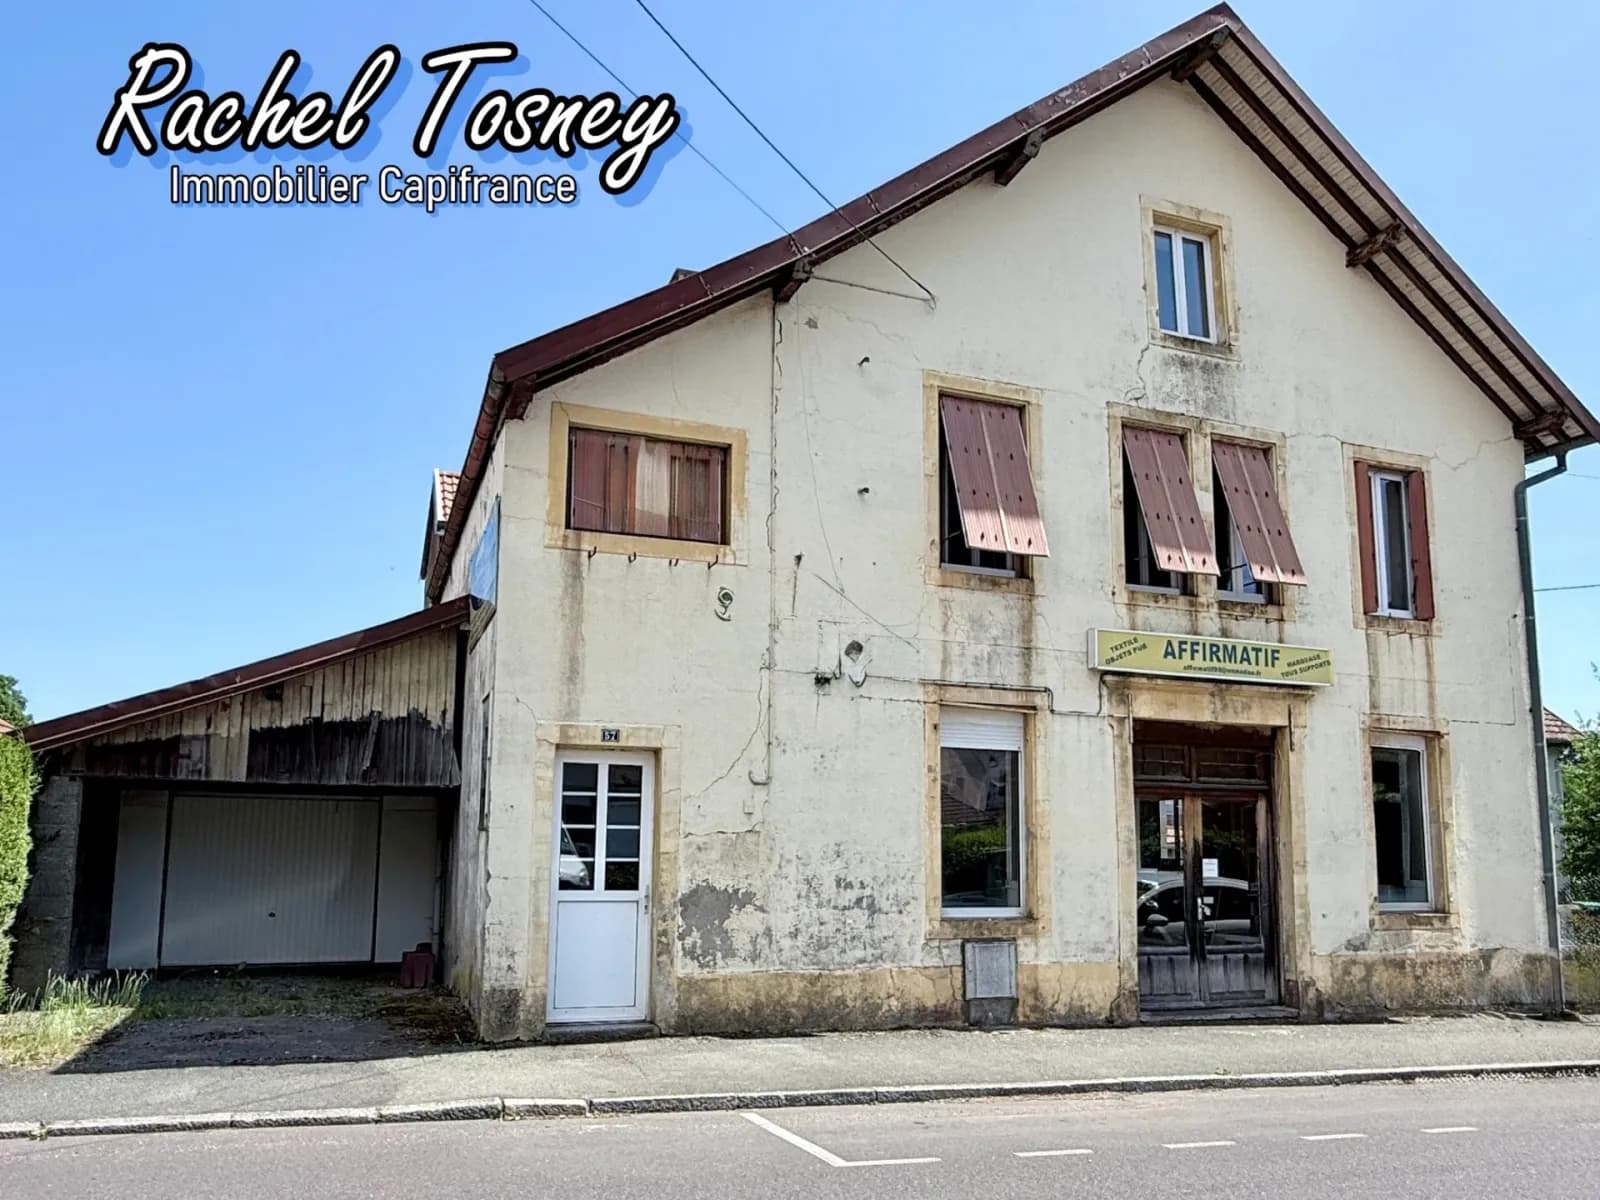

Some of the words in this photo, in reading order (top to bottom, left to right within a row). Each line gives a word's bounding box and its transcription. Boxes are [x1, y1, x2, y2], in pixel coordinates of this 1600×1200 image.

[1109, 636, 1139, 653] TEXTILE
[1104, 649, 1133, 665] OBJETS
[1162, 639, 1281, 668] AFFIRMATIF
[1286, 653, 1321, 668] MARQUAGE
[1280, 668, 1298, 678] TOUS
[1298, 659, 1332, 674] SUPPORTS
